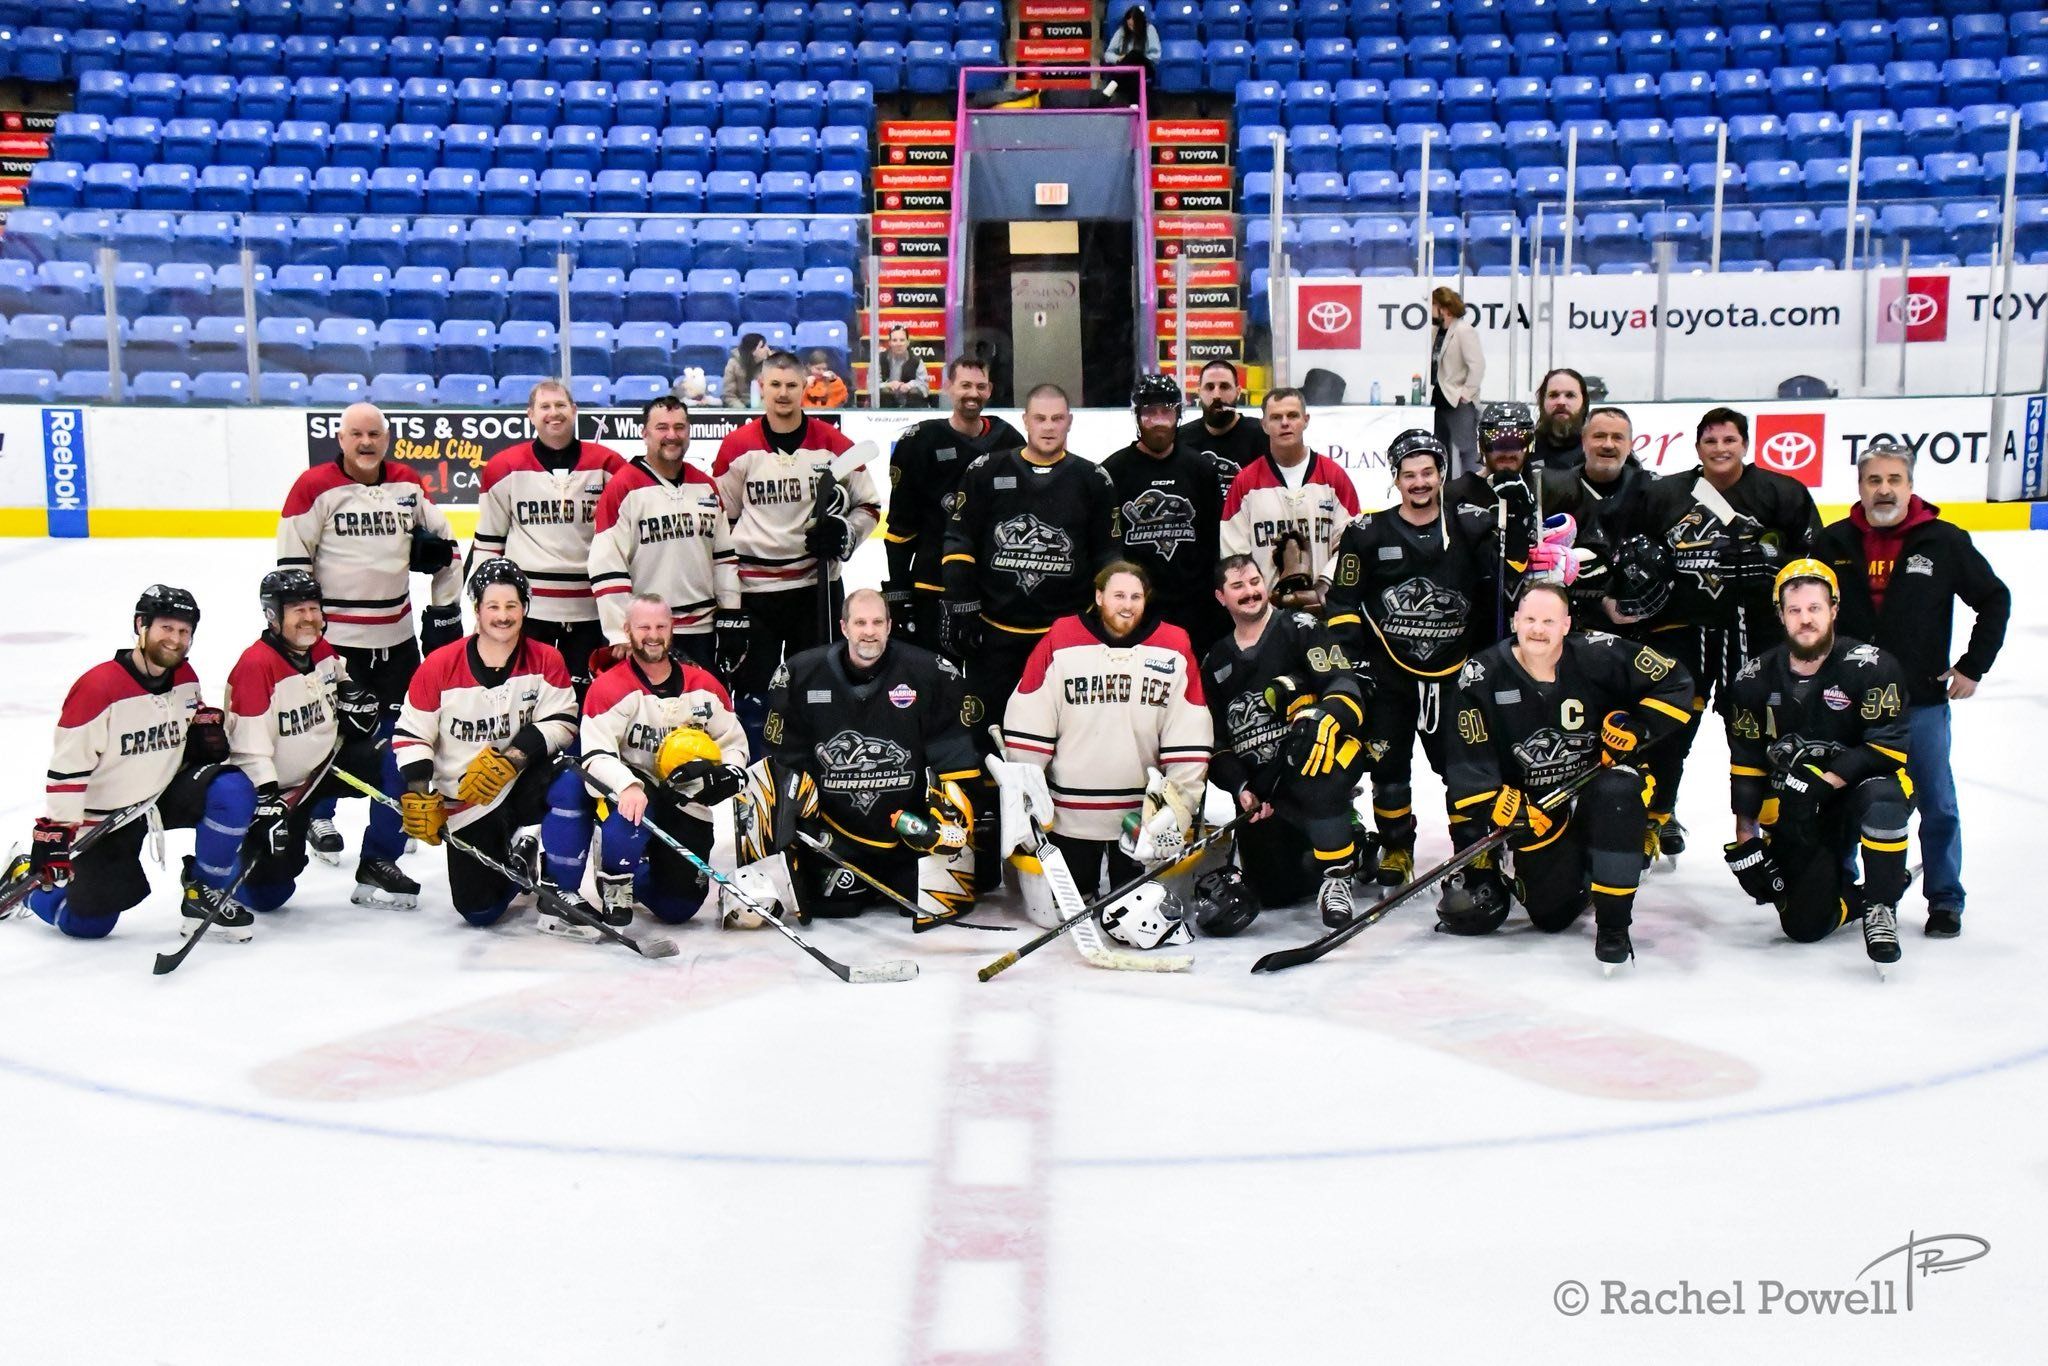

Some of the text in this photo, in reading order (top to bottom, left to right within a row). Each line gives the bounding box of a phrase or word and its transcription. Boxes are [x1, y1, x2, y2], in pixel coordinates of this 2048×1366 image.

[1046, 27, 1083, 36] TOYOTA
[26, 118, 56, 128] TOYO
[908, 151, 948, 160] TOYOTA
[1179, 150, 1219, 160] TOYOTA
[2, 162, 35, 171] TOYO
[904, 196, 944, 205] TOYOTA
[1182, 196, 1222, 206] TOYOTA
[901, 243, 941, 252] TOYOTA
[1186, 244, 1226, 253] TOYOTA
[878, 268, 941, 278] uyatoyota.com
[896, 293, 938, 303] TOYOTA
[1188, 293, 1230, 302] TOYOTA
[1378, 303, 1530, 330] TOOTA
[1569, 302, 1840, 336] buyatoyota.com
[1164, 319, 1234, 329] Butoyota.com
[1190, 345, 1233, 355] TOYOTA
[310, 416, 426, 439] SPTS
[433, 416, 454, 439] &
[49, 411, 80, 510] Reebok
[394, 438, 488, 469] Steel City
[746, 477, 801, 506] CRAKD
[517, 499, 575, 526] CRAKD
[334, 511, 397, 537] CRAKD
[639, 512, 695, 545] CRAKD
[1001, 550, 1065, 562] PITTSBURGH
[994, 556, 1072, 573] WARRIORS
[1341, 553, 1361, 587] 8
[1383, 623, 1466, 638] WARRIORS
[1145, 658, 1175, 672] GUNDS
[1306, 644, 1352, 673] 84
[1064, 674, 1171, 708] CRAKD ICE
[1861, 683, 1901, 720] 94
[1560, 698, 1585, 731] C
[1457, 708, 1488, 745] 91
[120, 719, 181, 756] CRAKD
[830, 769, 899, 779] PITTSBURGH
[824, 775, 912, 789] WARRIORS
